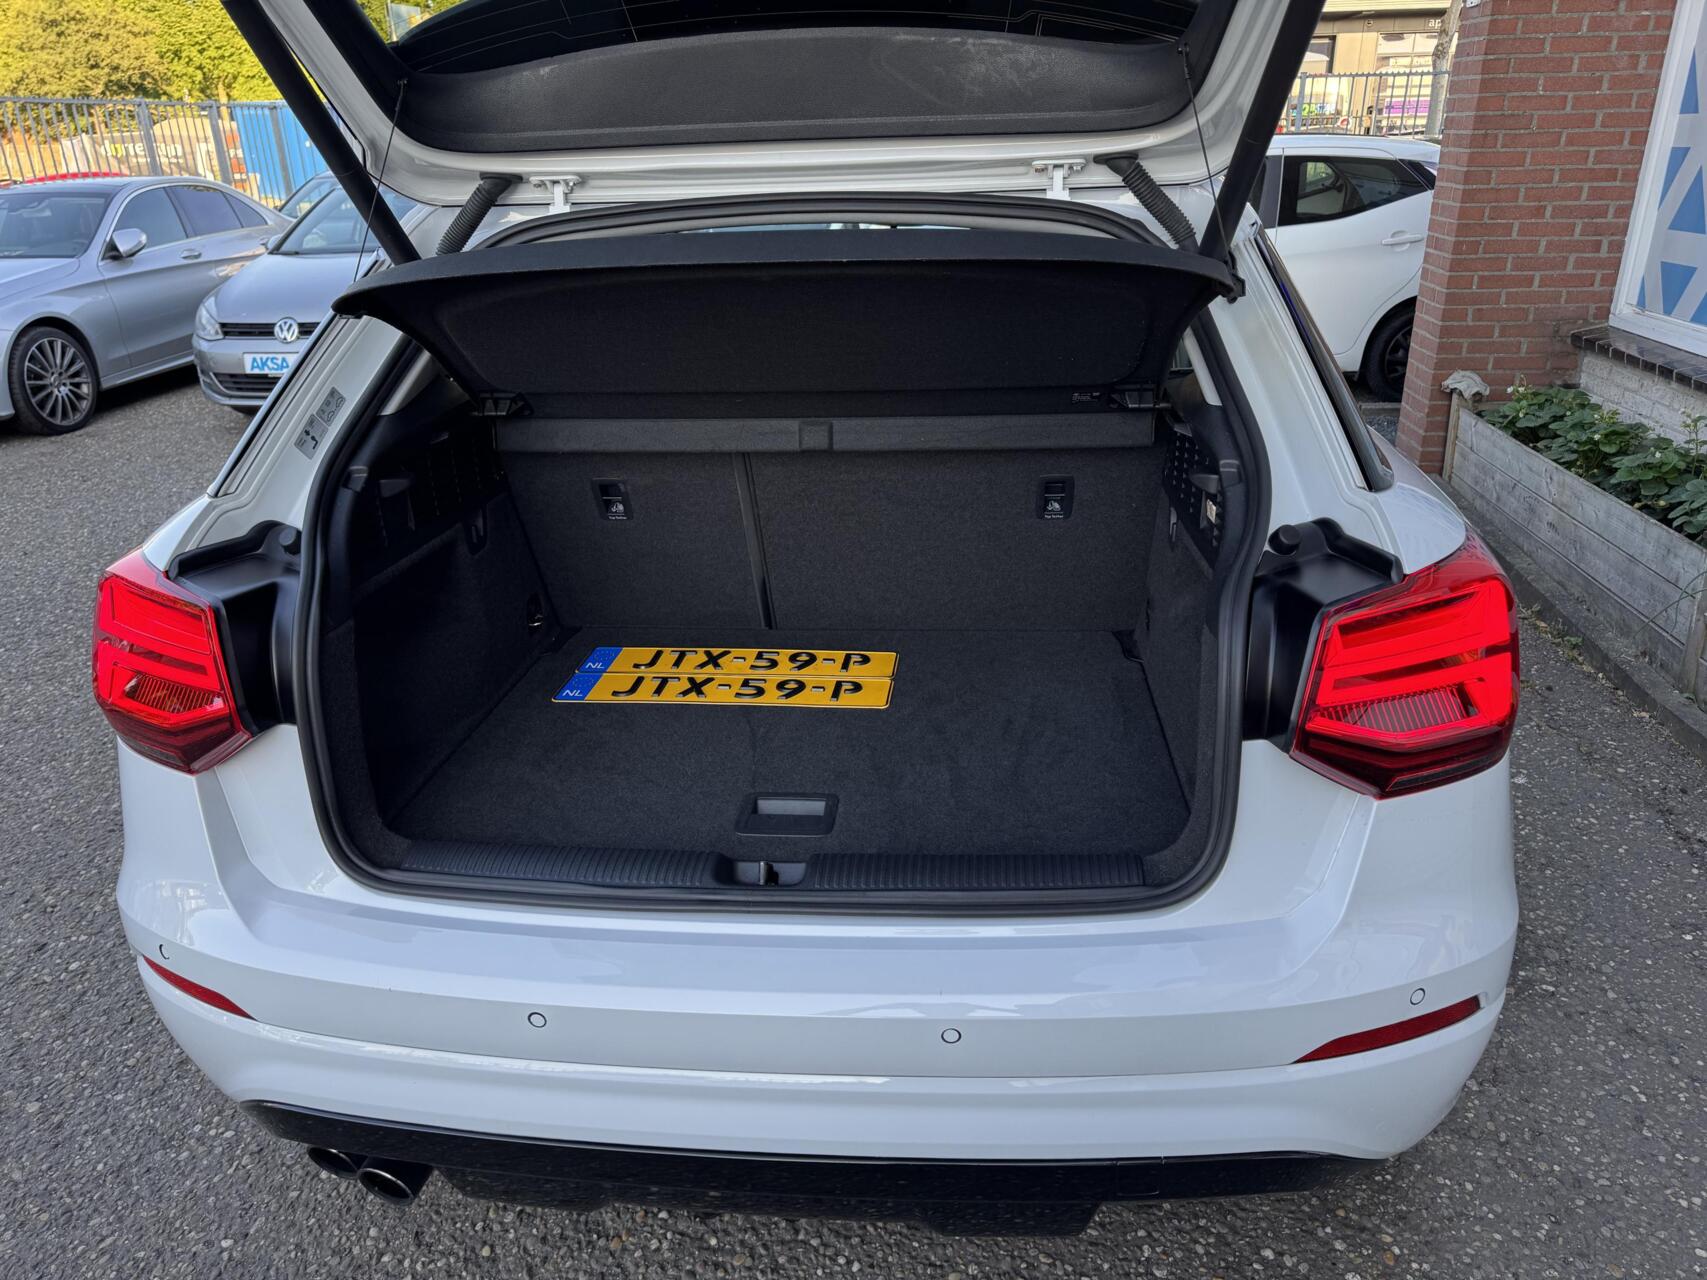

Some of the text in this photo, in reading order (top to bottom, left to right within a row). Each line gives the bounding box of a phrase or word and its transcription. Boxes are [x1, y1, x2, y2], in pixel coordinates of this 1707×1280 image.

[1428, 19, 1442, 29] ap
[250, 356, 290, 372] AKSA
[585, 650, 872, 672] NL JTX-59-P
[562, 676, 864, 702] NL JTX-59-P
